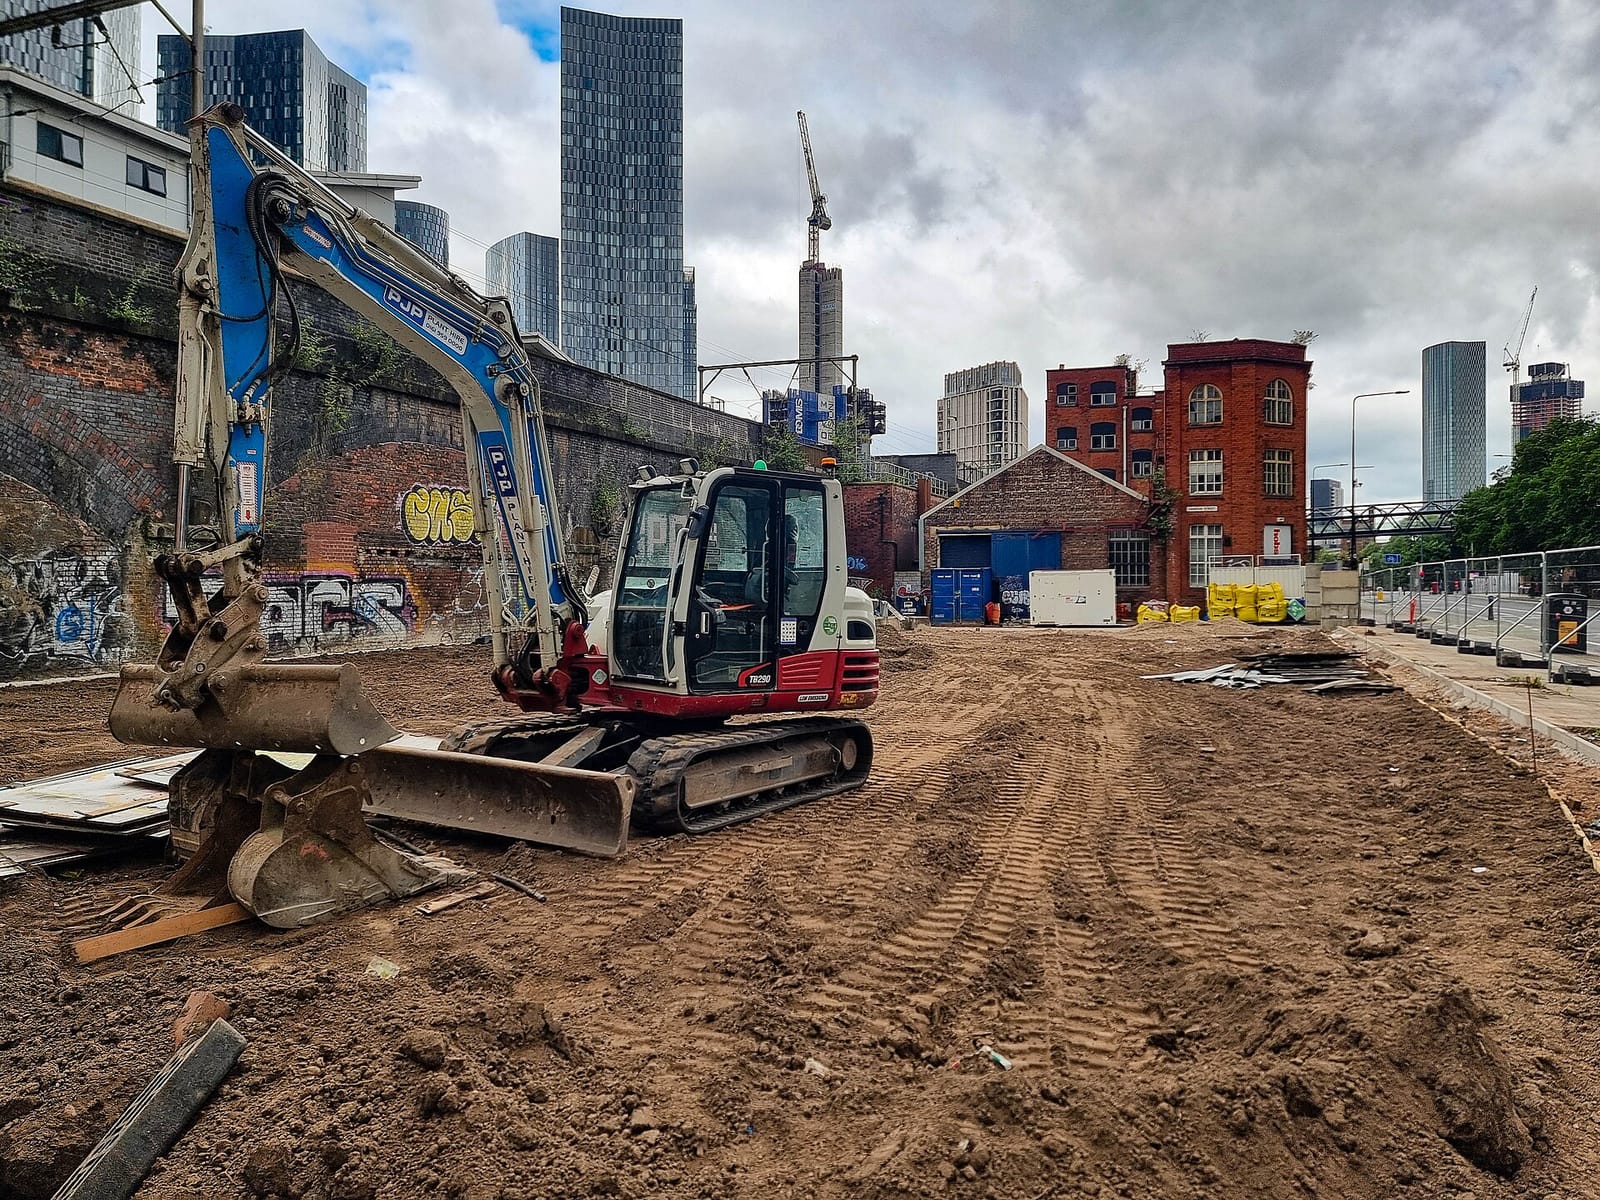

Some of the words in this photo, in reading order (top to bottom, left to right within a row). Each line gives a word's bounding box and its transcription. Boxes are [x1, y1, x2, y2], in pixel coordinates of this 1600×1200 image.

[387, 287, 424, 319] PJP
[427, 314, 449, 332] PLANT
[449, 330, 465, 345] HIRE
[491, 451, 513, 492] PJP
[507, 502, 525, 550] PLANT
[749, 674, 771, 683] TB290
